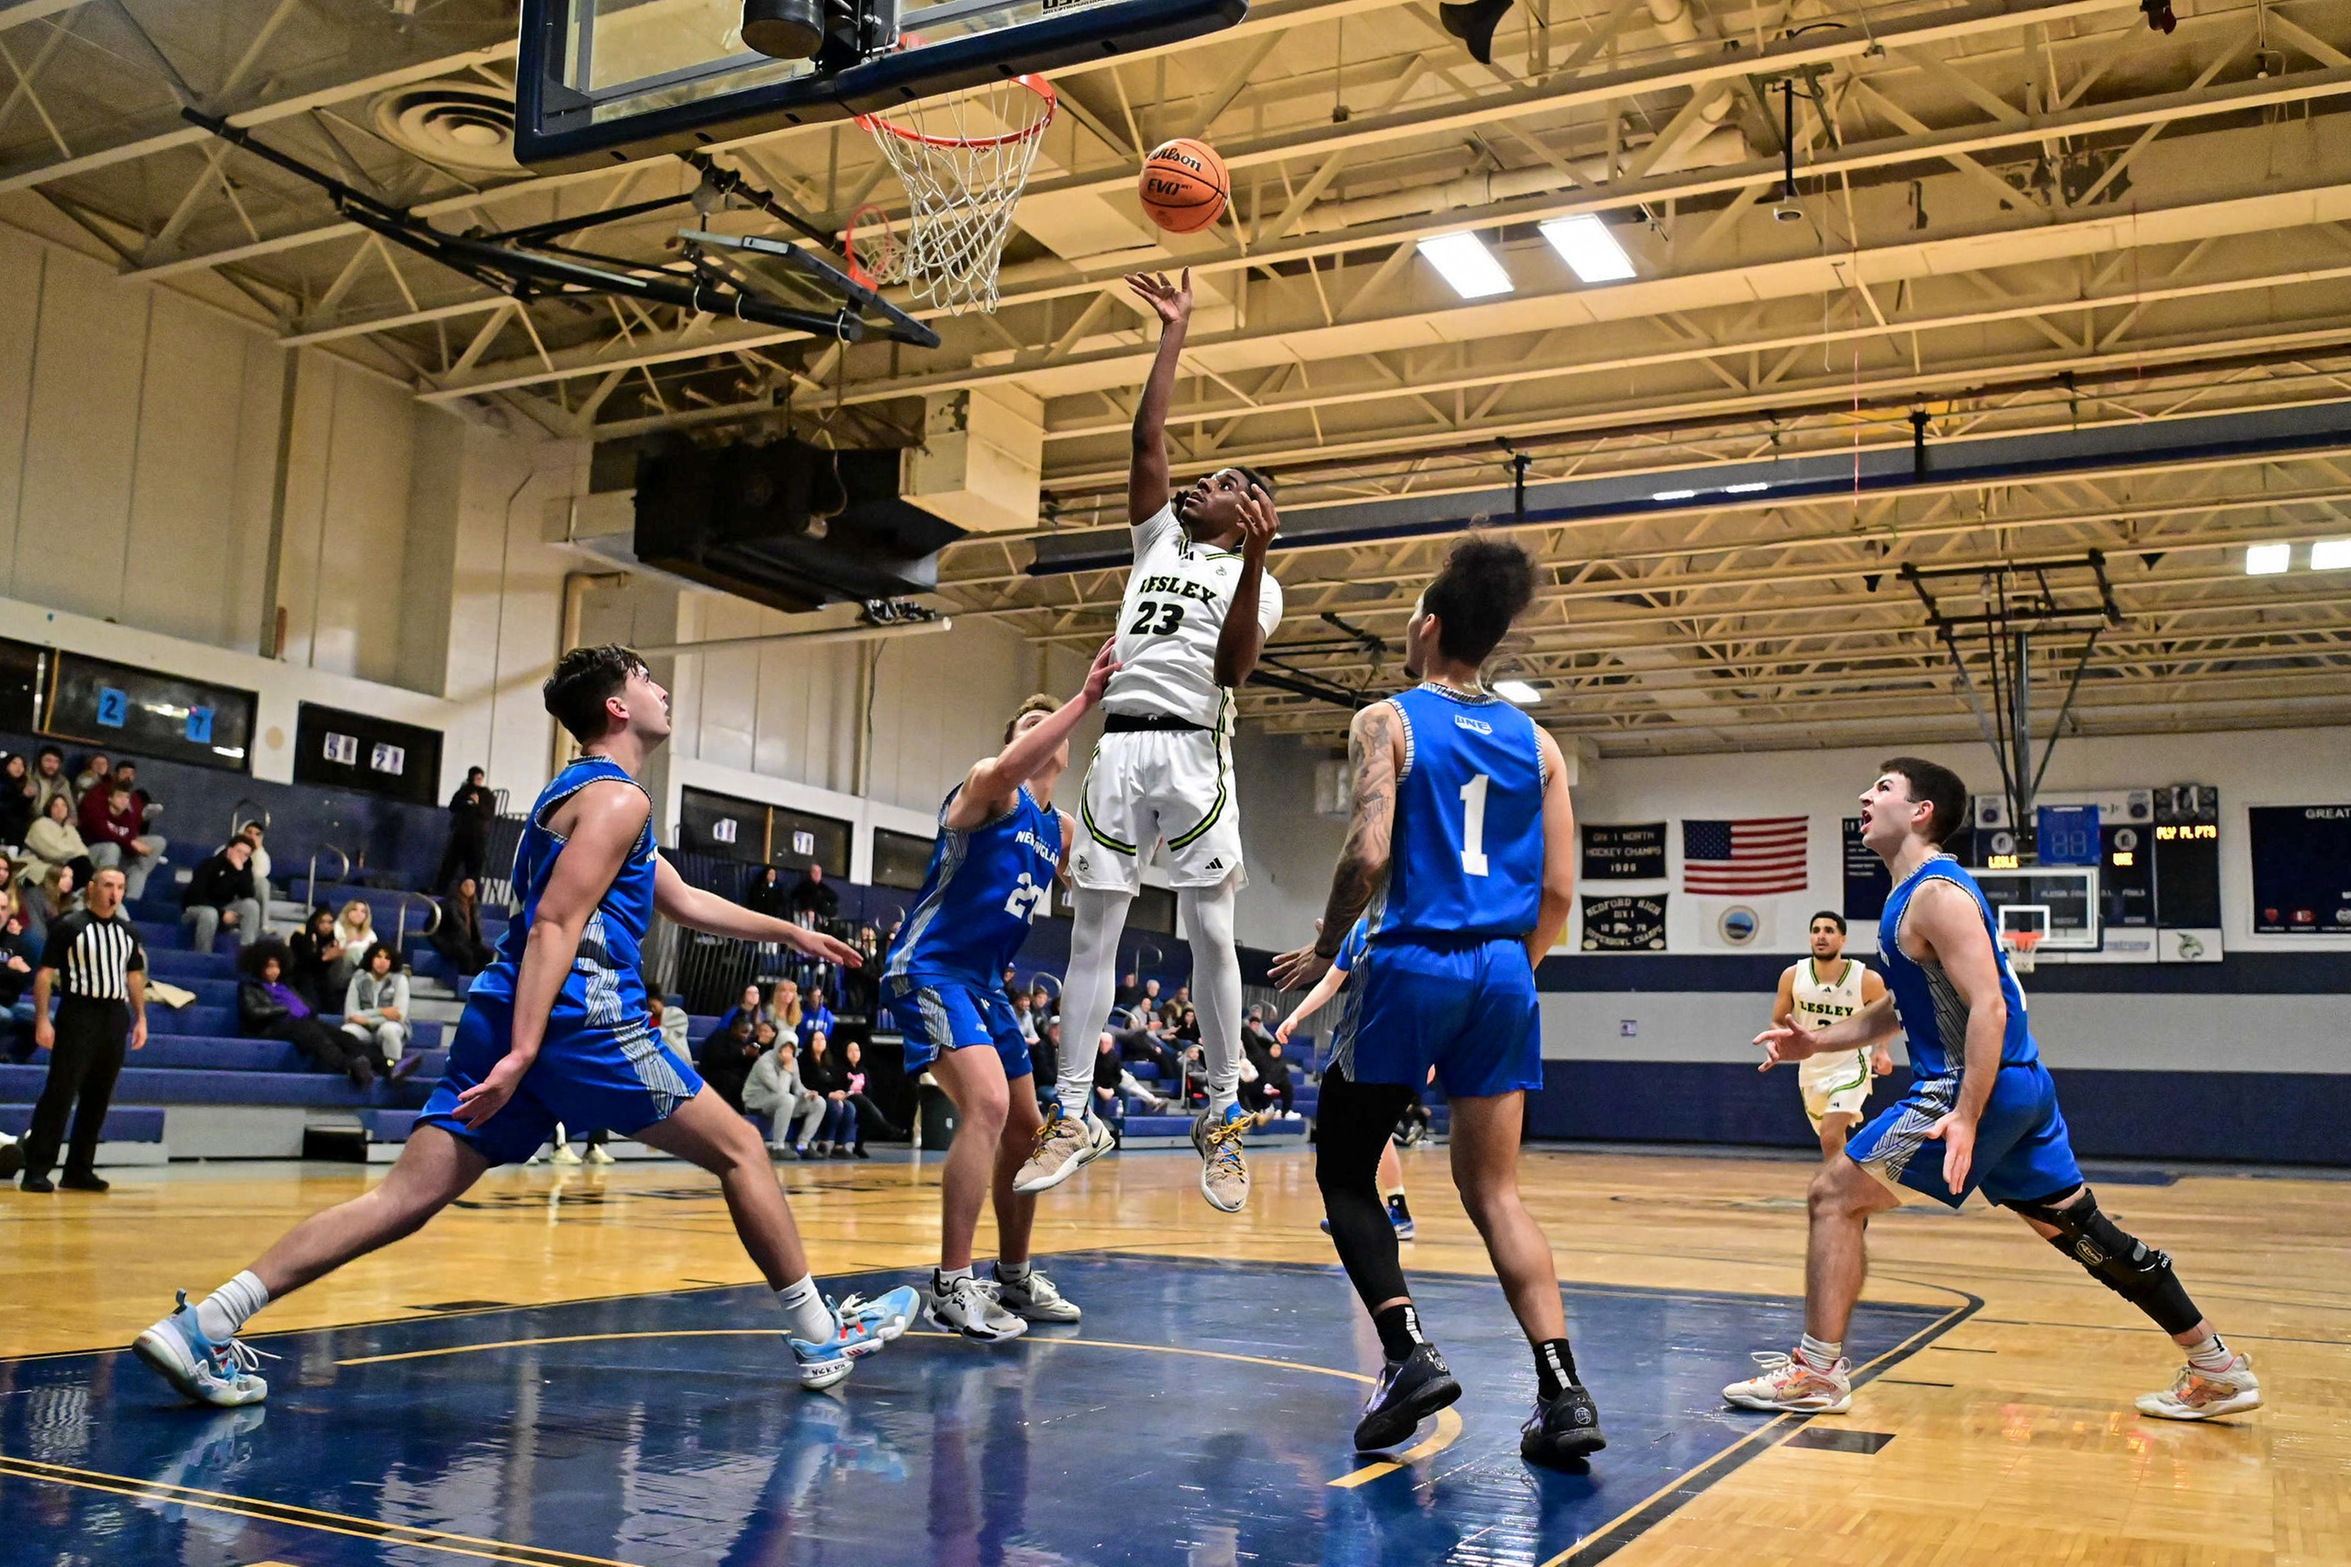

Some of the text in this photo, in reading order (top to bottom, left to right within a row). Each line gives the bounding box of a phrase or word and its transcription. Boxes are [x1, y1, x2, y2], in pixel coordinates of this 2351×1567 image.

[1147, 178, 1181, 196] EVO
[1129, 601, 1185, 636] 23
[105, 694, 118, 719] 2
[1456, 715, 1492, 734] UNE
[1459, 773, 1490, 878] 1
[1624, 846, 1662, 857] CHAMPS
[1799, 1000, 1854, 1017] LESLEY
